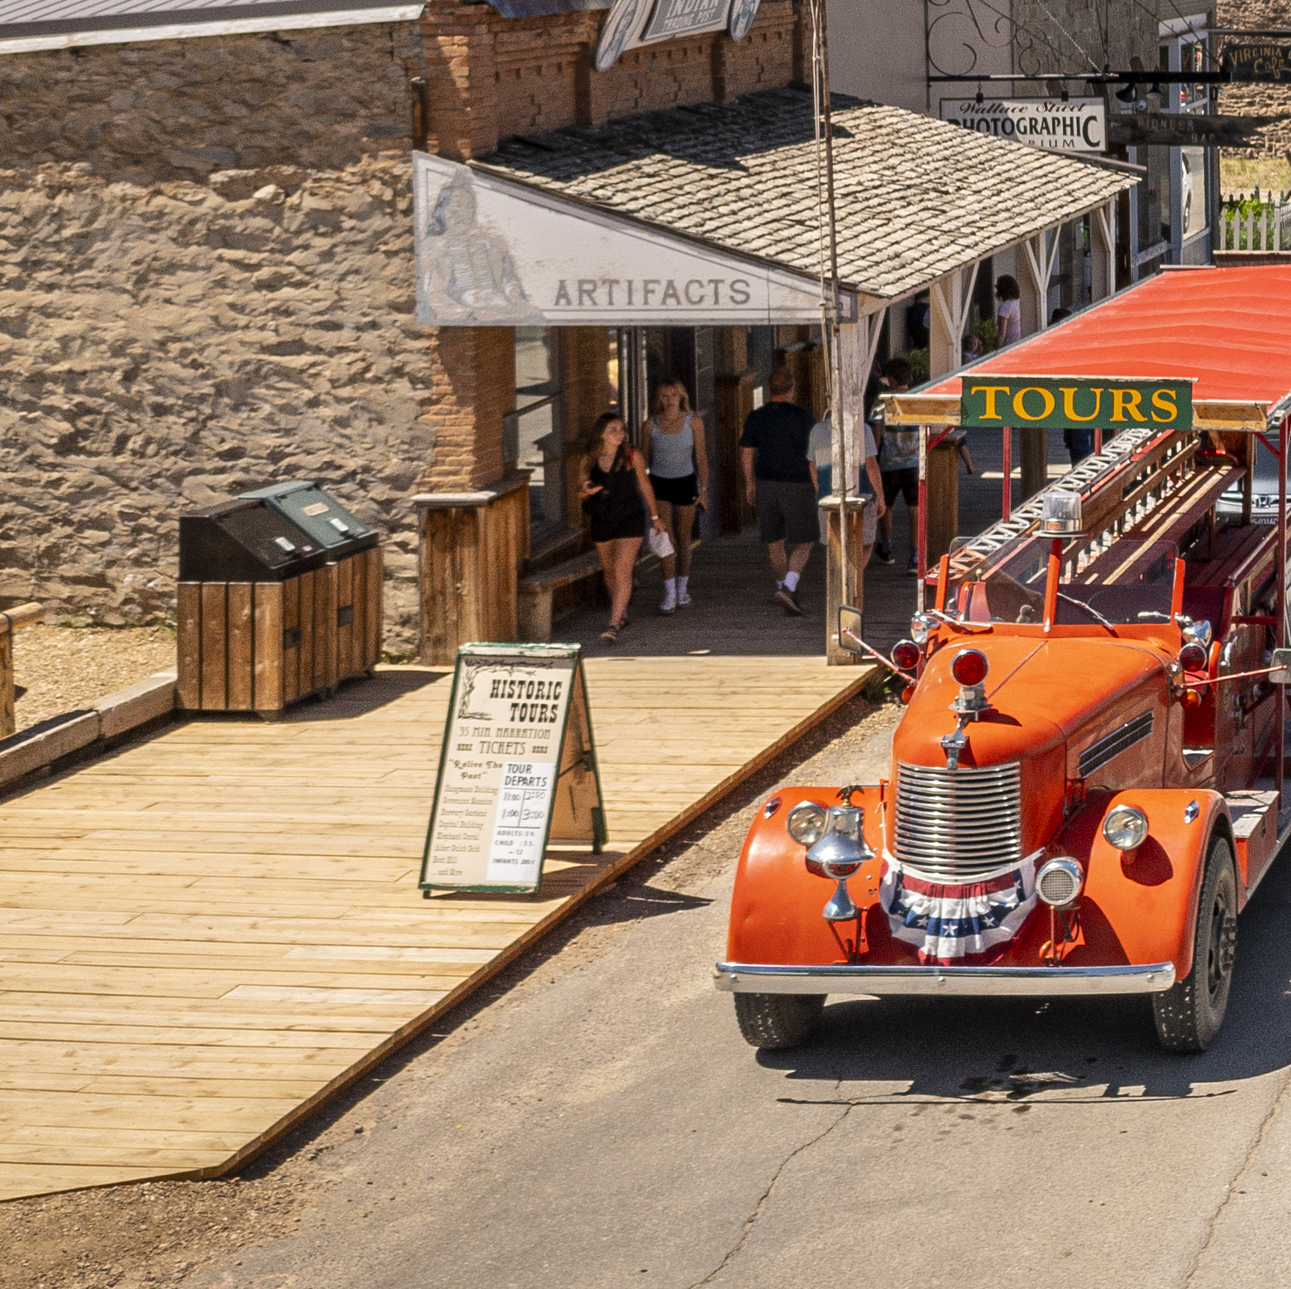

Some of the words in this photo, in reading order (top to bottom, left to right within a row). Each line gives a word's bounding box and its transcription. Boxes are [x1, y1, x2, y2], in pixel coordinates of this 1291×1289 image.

[696, 9, 717, 24] POST
[959, 101, 1028, 114] Wallace
[1036, 101, 1086, 113] Street
[946, 115, 1101, 147] HOTOGRAPHIC
[1137, 117, 1194, 131] PIONEER
[1192, 133, 1215, 144] BAR
[553, 279, 751, 306] ARTIFACTS
[971, 385, 1179, 423] TOURS
[490, 679, 563, 701] HISTORIC
[510, 702, 559, 724] TOURS
[459, 726, 469, 737] 35
[495, 728, 551, 740] NARRATION
[479, 741, 526, 755] TICKETS
[507, 763, 532, 774] TOUR
[504, 775, 548, 787] DEPARTS
[522, 808, 545, 820] 3:00
